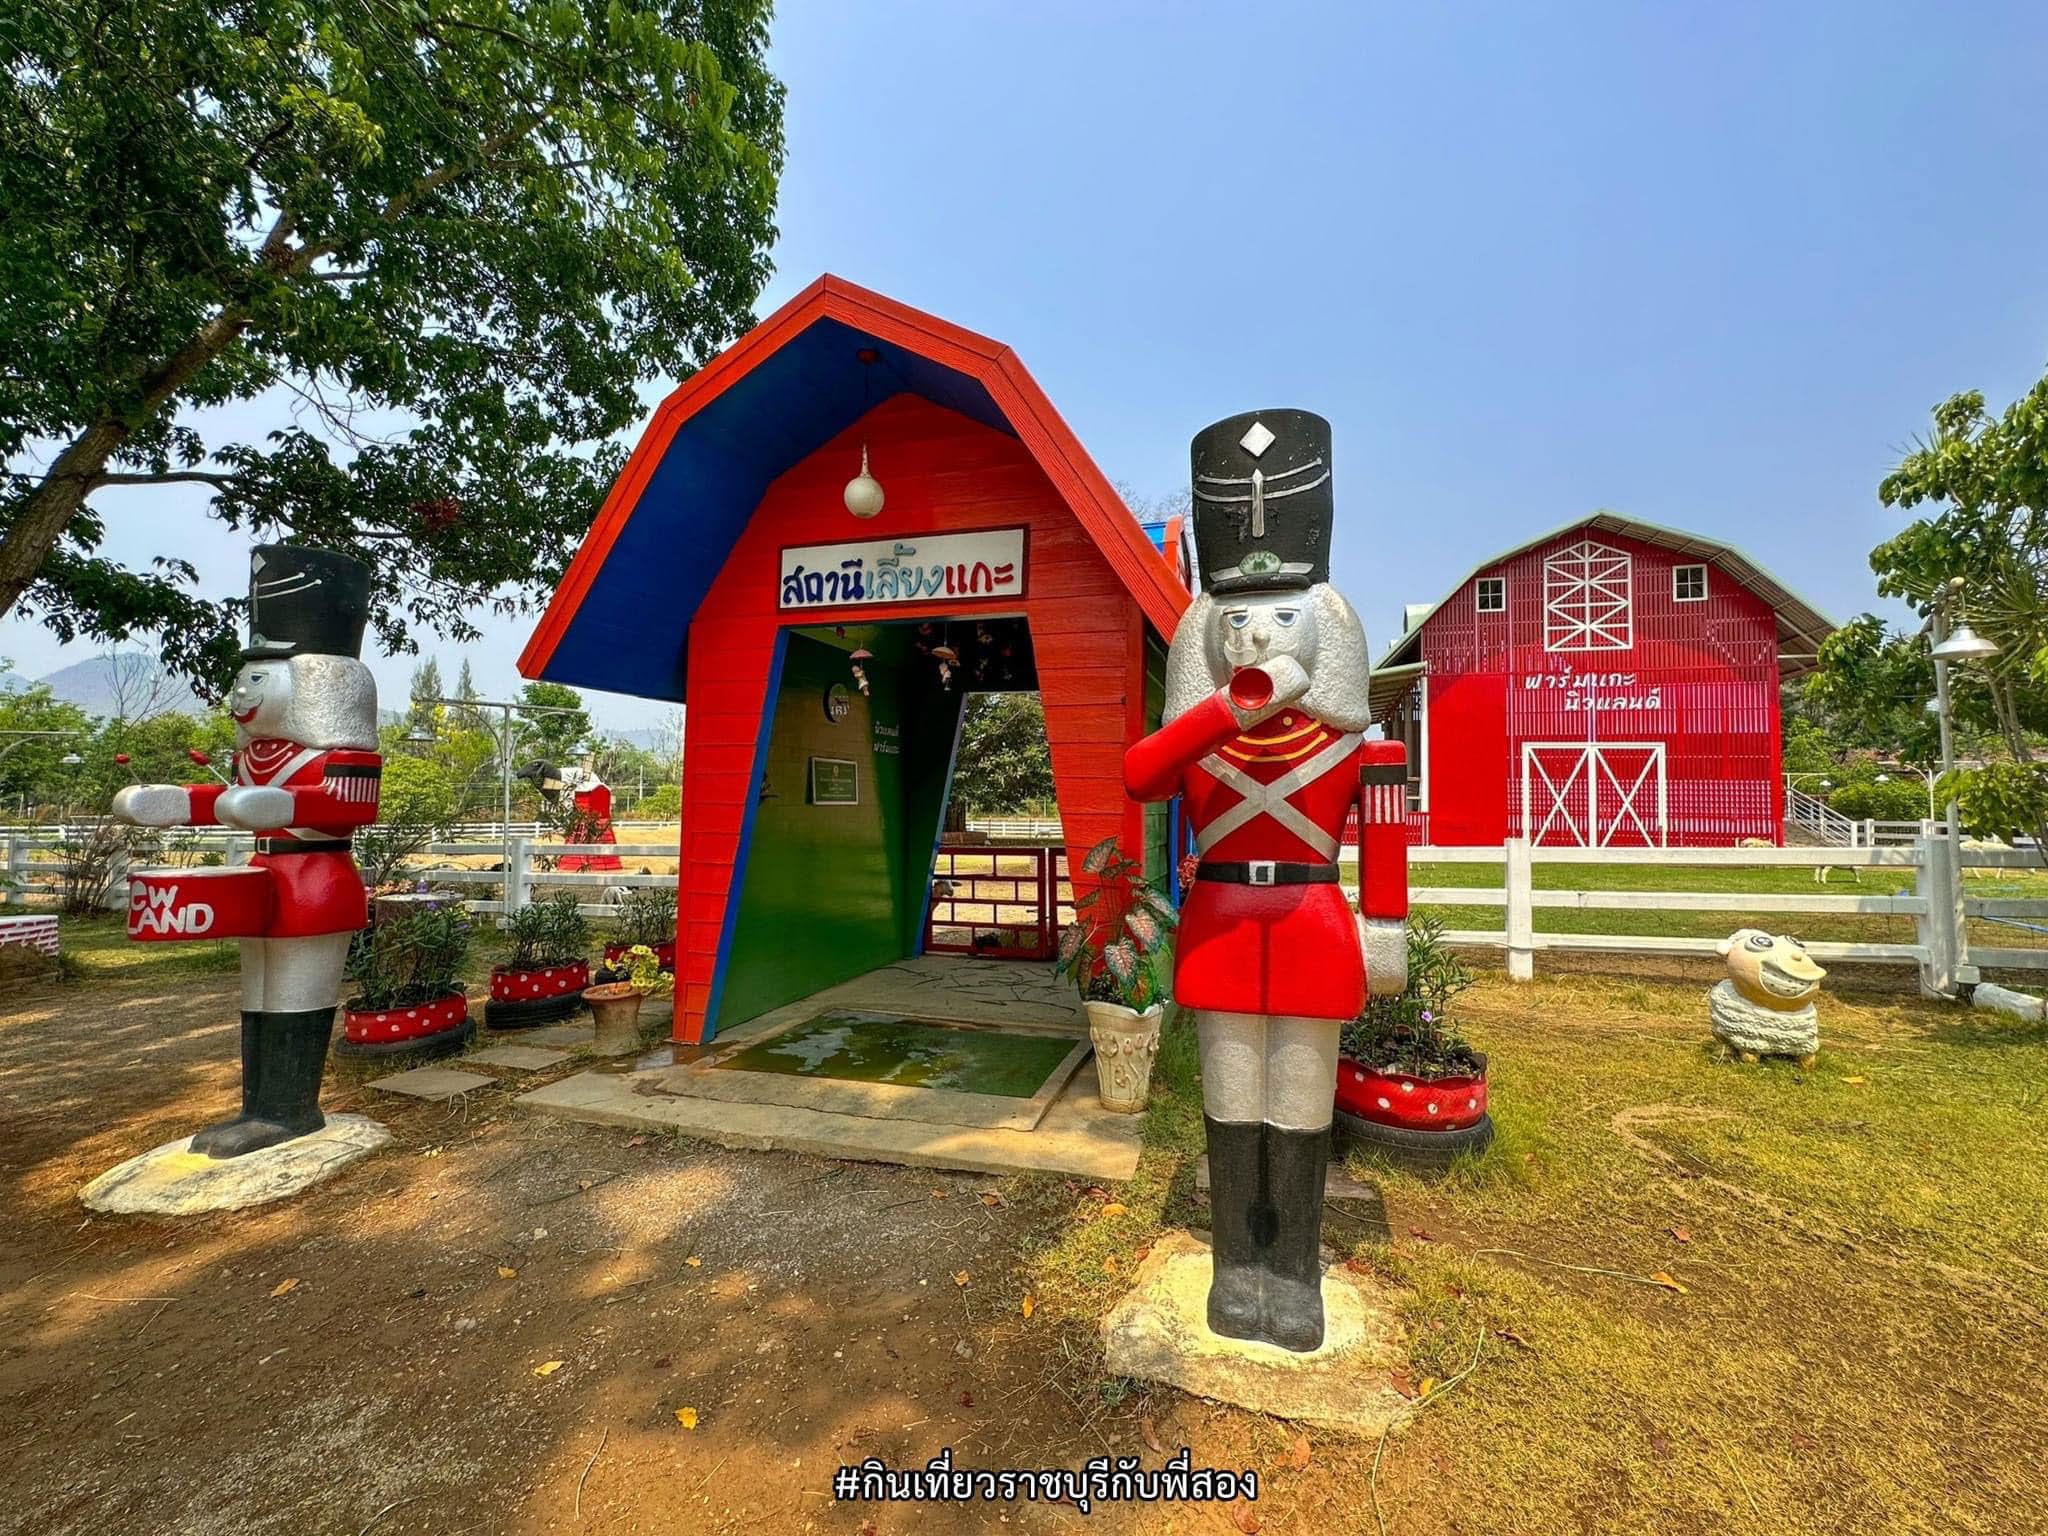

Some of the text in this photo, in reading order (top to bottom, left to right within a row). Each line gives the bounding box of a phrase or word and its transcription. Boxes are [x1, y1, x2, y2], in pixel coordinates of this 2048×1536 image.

[783, 544, 1014, 604] สถานีเลี้ยงแกะ
[1525, 665, 1636, 689] ฟาร์มแกะ
[1564, 687, 1662, 711] นิวแลนด์
[128, 903, 214, 934] LAND
